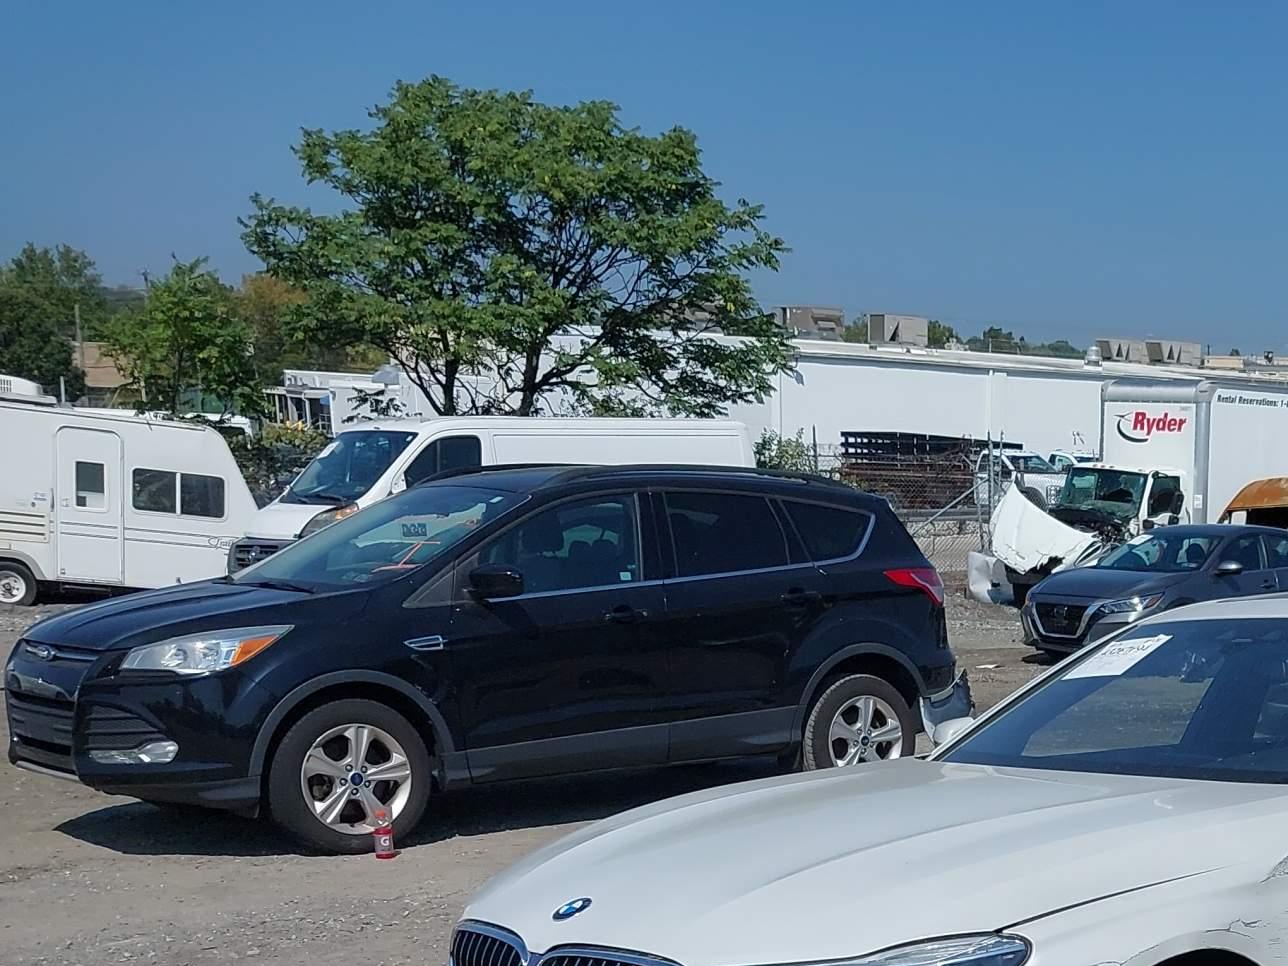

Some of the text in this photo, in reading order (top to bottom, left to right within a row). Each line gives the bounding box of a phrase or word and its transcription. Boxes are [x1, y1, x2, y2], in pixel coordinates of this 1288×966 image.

[1217, 395, 1236, 404] Rental
[1238, 396, 1279, 407] Reservations:
[1133, 411, 1187, 436] Ryder
[380, 836, 390, 846] G
